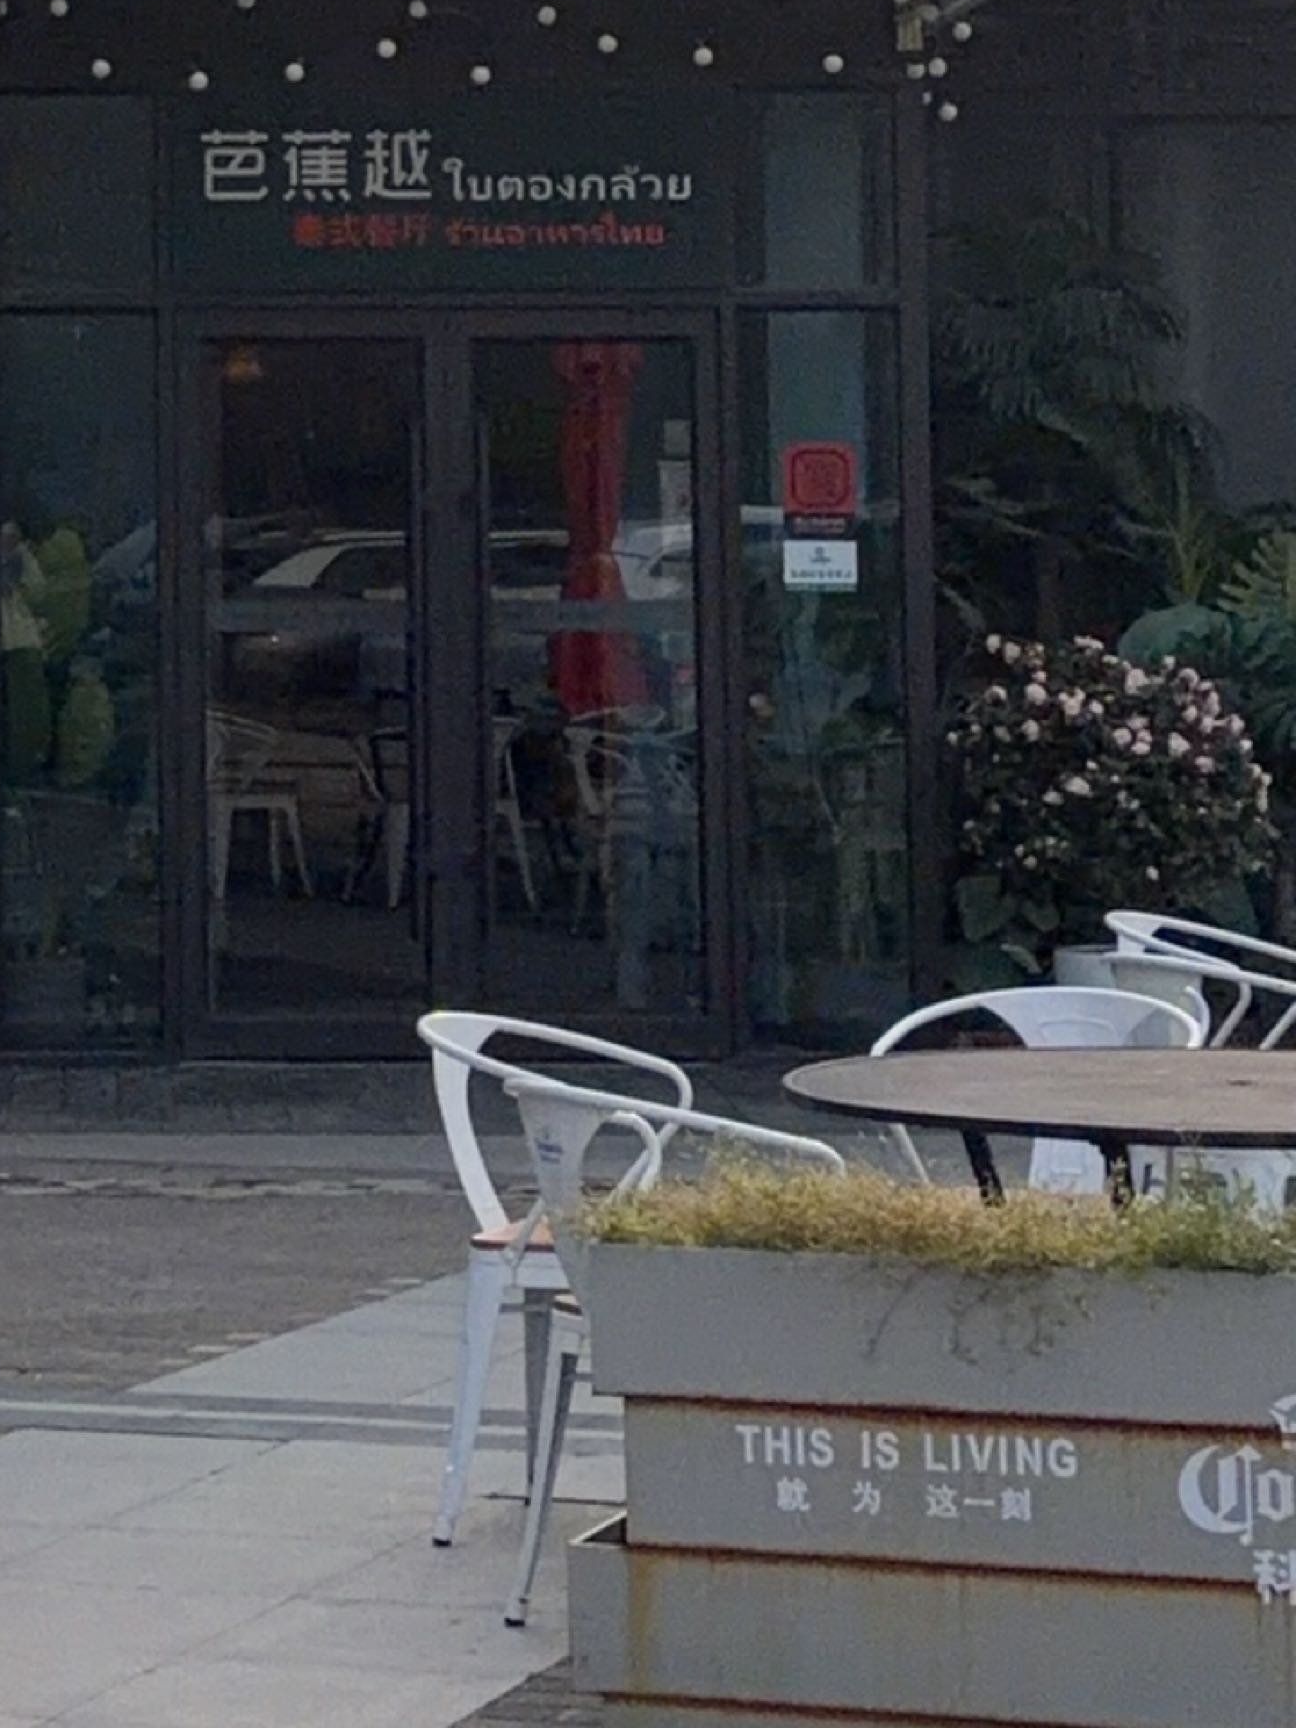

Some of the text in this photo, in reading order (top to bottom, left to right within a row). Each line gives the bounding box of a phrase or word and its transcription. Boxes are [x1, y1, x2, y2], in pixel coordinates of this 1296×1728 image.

[201, 129, 432, 202] 芭蕉越
[734, 1425, 1079, 1478] THIS IS LIVING
[851, 1480, 882, 1516] 为
[925, 1484, 1033, 1522] 这一刻
